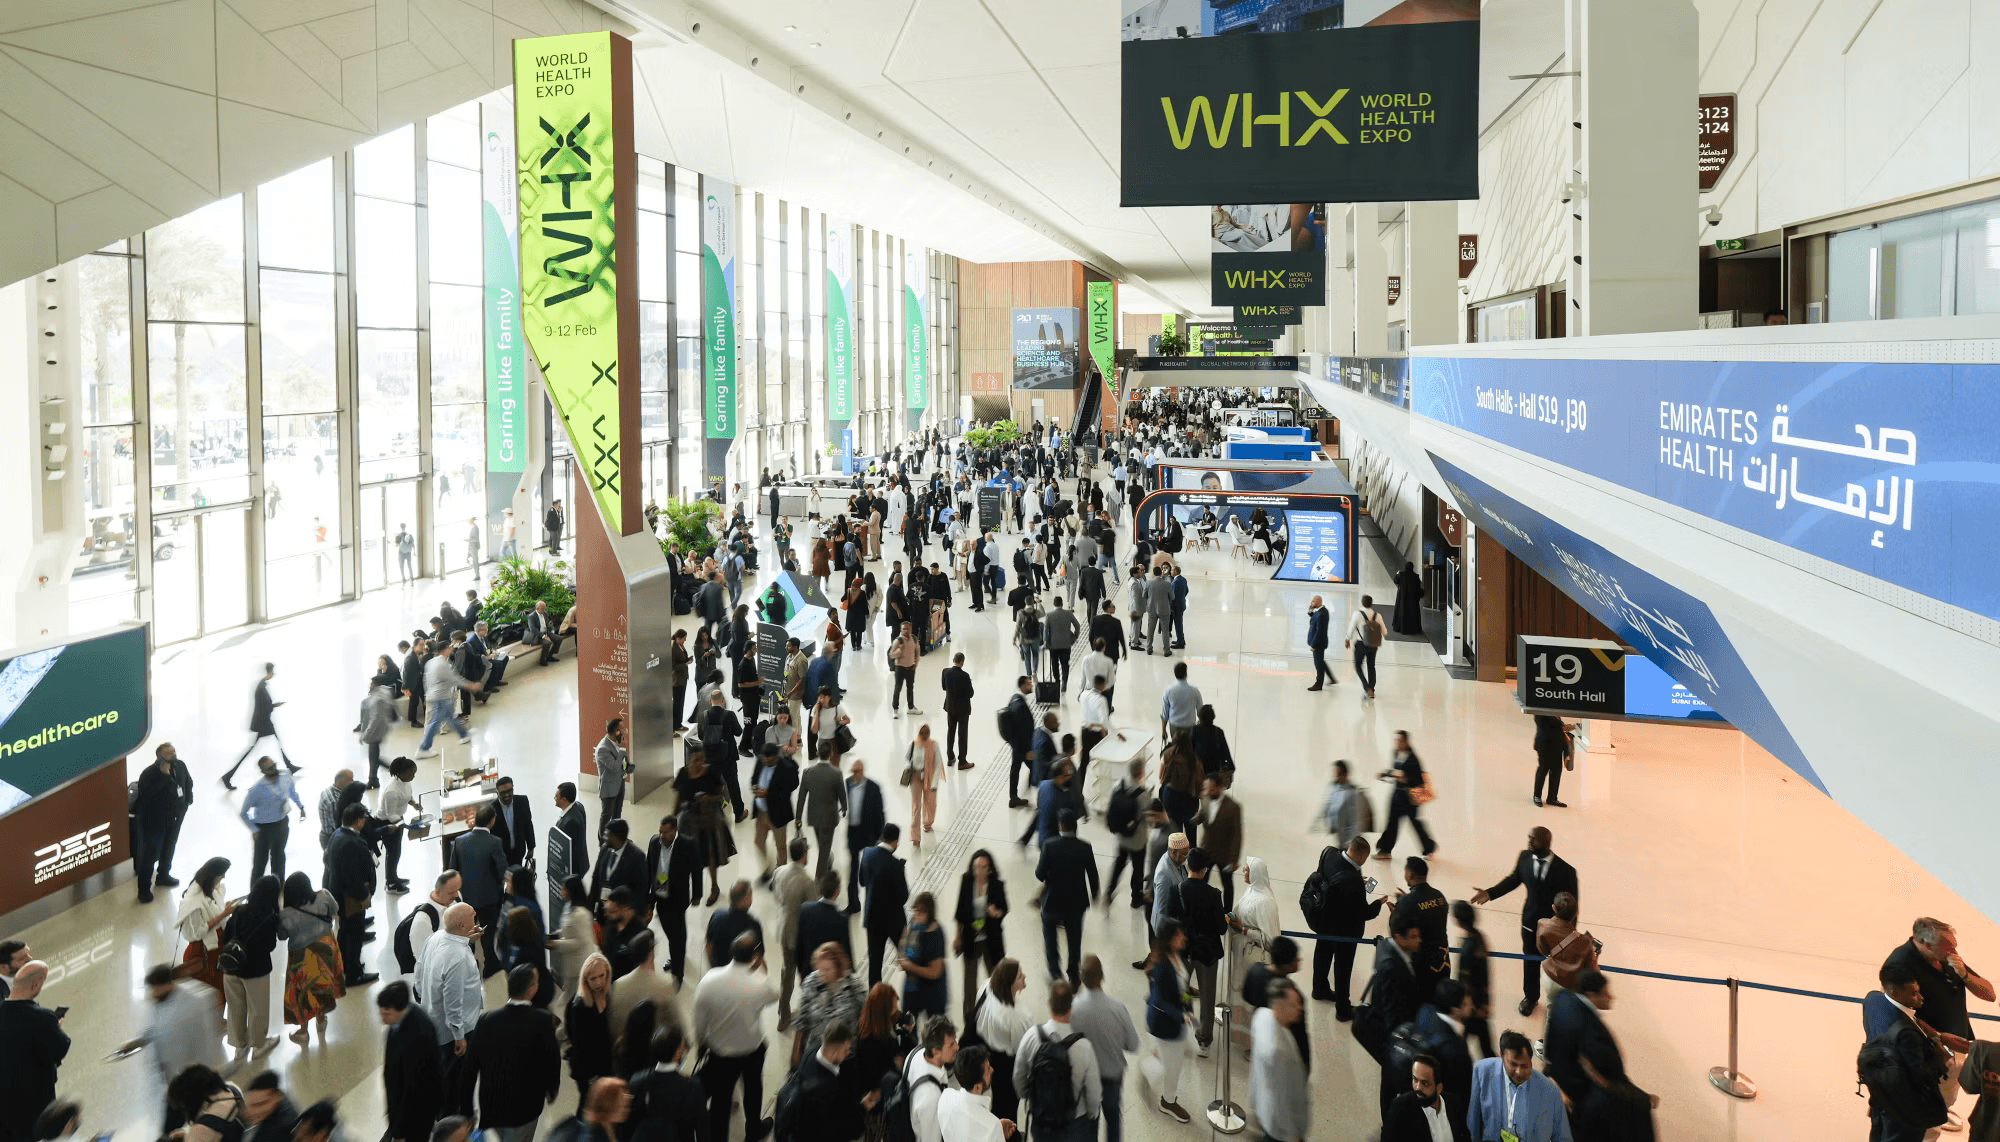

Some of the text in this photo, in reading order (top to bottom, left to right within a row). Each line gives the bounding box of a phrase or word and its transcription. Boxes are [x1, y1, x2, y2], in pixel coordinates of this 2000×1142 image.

[536, 52, 588, 68] WORLD
[536, 67, 591, 82] HEALTH
[536, 84, 574, 98] EXPO
[1360, 93, 1432, 108] WORLD
[1161, 88, 1350, 150] WHX
[1360, 110, 1435, 126] HEALTH
[1360, 128, 1412, 144] EXPO
[539, 112, 594, 308] WHX
[1224, 270, 1286, 289] WHX
[544, 324, 597, 337] 9-12 Feb
[1094, 300, 1108, 344] WHX
[497, 288, 516, 462] Caring like family
[714, 306, 728, 431] Caring like family
[835, 317, 846, 415] Caring like family
[912, 324, 922, 404] Caring like family
[1476, 386, 1494, 410] South
[1496, 388, 1512, 414] Halls
[1520, 392, 1536, 420] Hall
[1538, 394, 1558, 424] S19
[1566, 399, 1587, 433] J30
[1660, 401, 1757, 445] EMIRATES
[1772, 404, 1916, 466] صحة
[1660, 436, 1732, 481] HEALTH
[1743, 453, 1914, 548] الإمارات
[1533, 653, 1583, 685] 19
[1535, 688, 1606, 702] South Hall
[0, 710, 119, 759] healthcare
[34, 822, 110, 870] DEC
[35, 846, 111, 884] DUBAI EXHIBITION CENTRE
[1418, 899, 1438, 910] WHX
